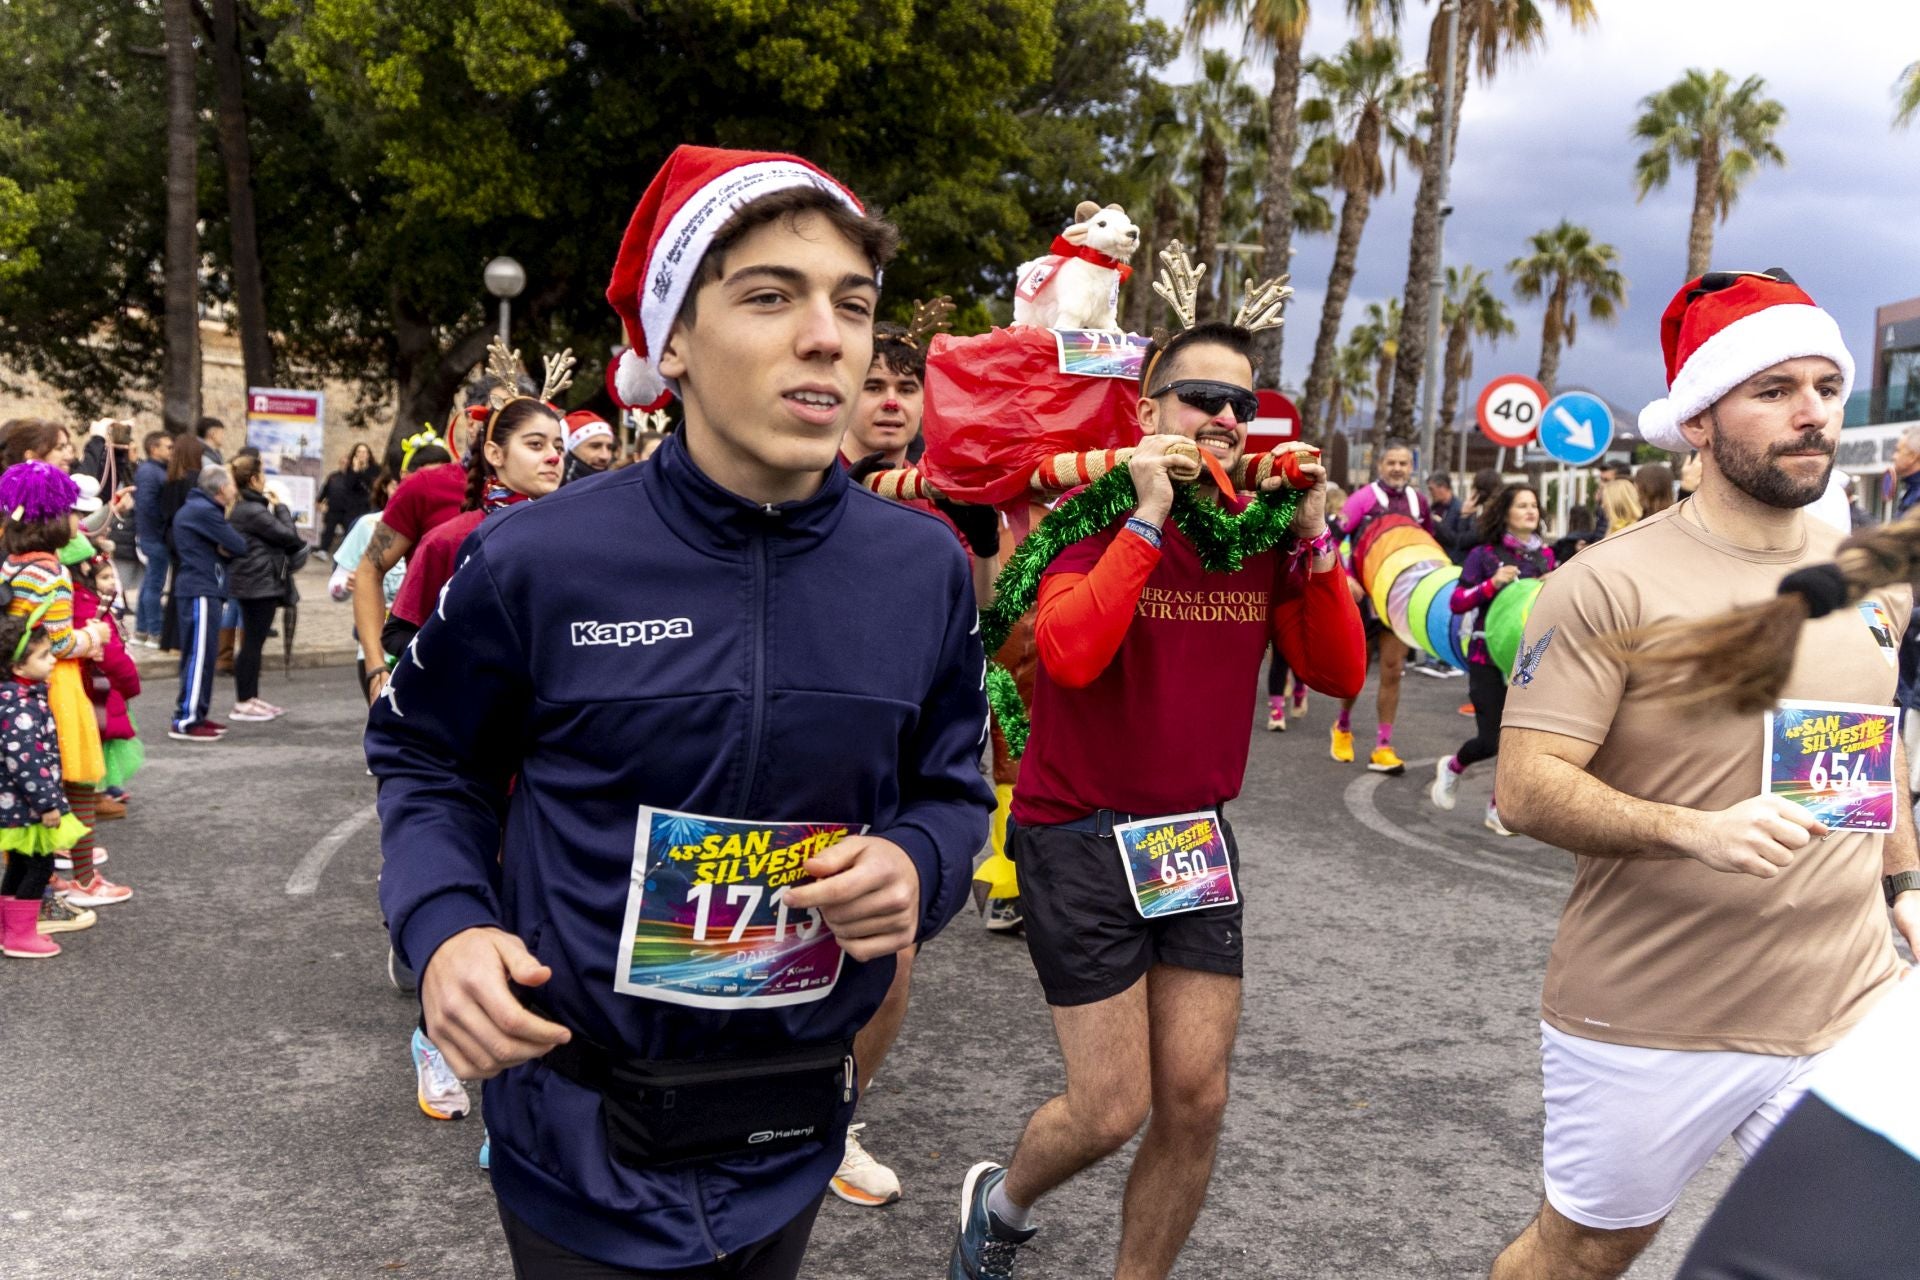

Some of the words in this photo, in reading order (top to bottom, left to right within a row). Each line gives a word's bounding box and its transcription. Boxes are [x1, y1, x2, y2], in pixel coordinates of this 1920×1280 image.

[1494, 399, 1533, 423] 40
[1209, 591, 1268, 606] CHOQUE
[571, 617, 693, 647] Kappa
[1801, 715, 1841, 736] SAN
[1801, 718, 1887, 754] SILVESTRE
[1809, 752, 1869, 792] 654
[698, 830, 773, 860] SAN
[1146, 825, 1175, 847] SAN
[1149, 820, 1211, 860] SILVESTRE
[1160, 849, 1208, 884] 650
[774, 1125, 814, 1139] Kalenji
